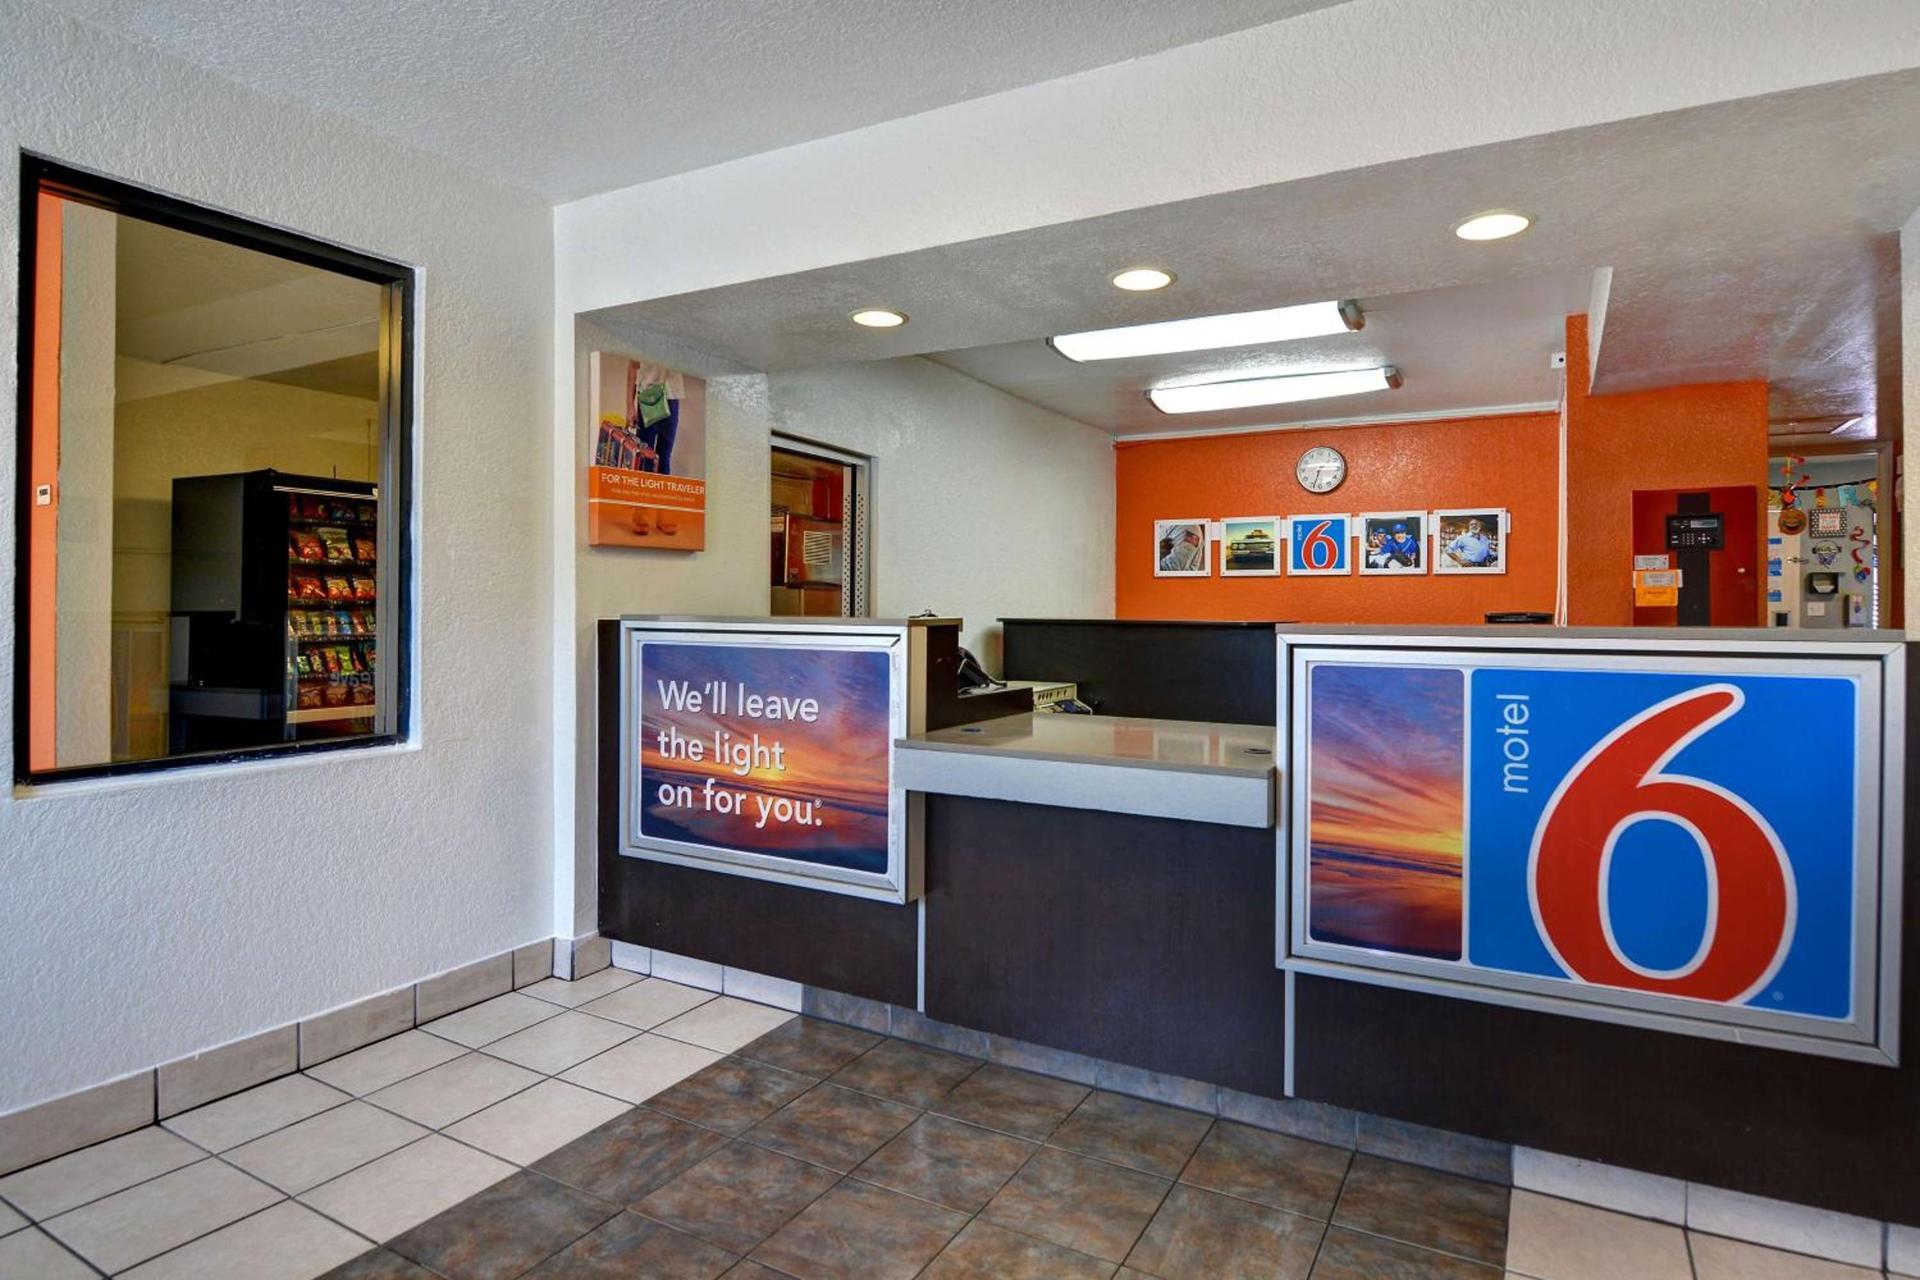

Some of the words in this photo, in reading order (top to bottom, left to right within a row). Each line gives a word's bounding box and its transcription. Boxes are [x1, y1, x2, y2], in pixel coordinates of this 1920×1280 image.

[601, 473, 620, 484] FOR
[622, 476, 639, 487] THE
[641, 479, 665, 491] LIGHT
[667, 483, 704, 495] TRAVELER
[1301, 520, 1338, 570] 6
[737, 682, 819, 722] leave
[657, 726, 704, 761] the
[715, 730, 786, 777] light
[658, 783, 692, 808] on
[703, 778, 746, 815] for
[1496, 694, 1530, 793] motel
[1526, 683, 1798, 1005] 6
